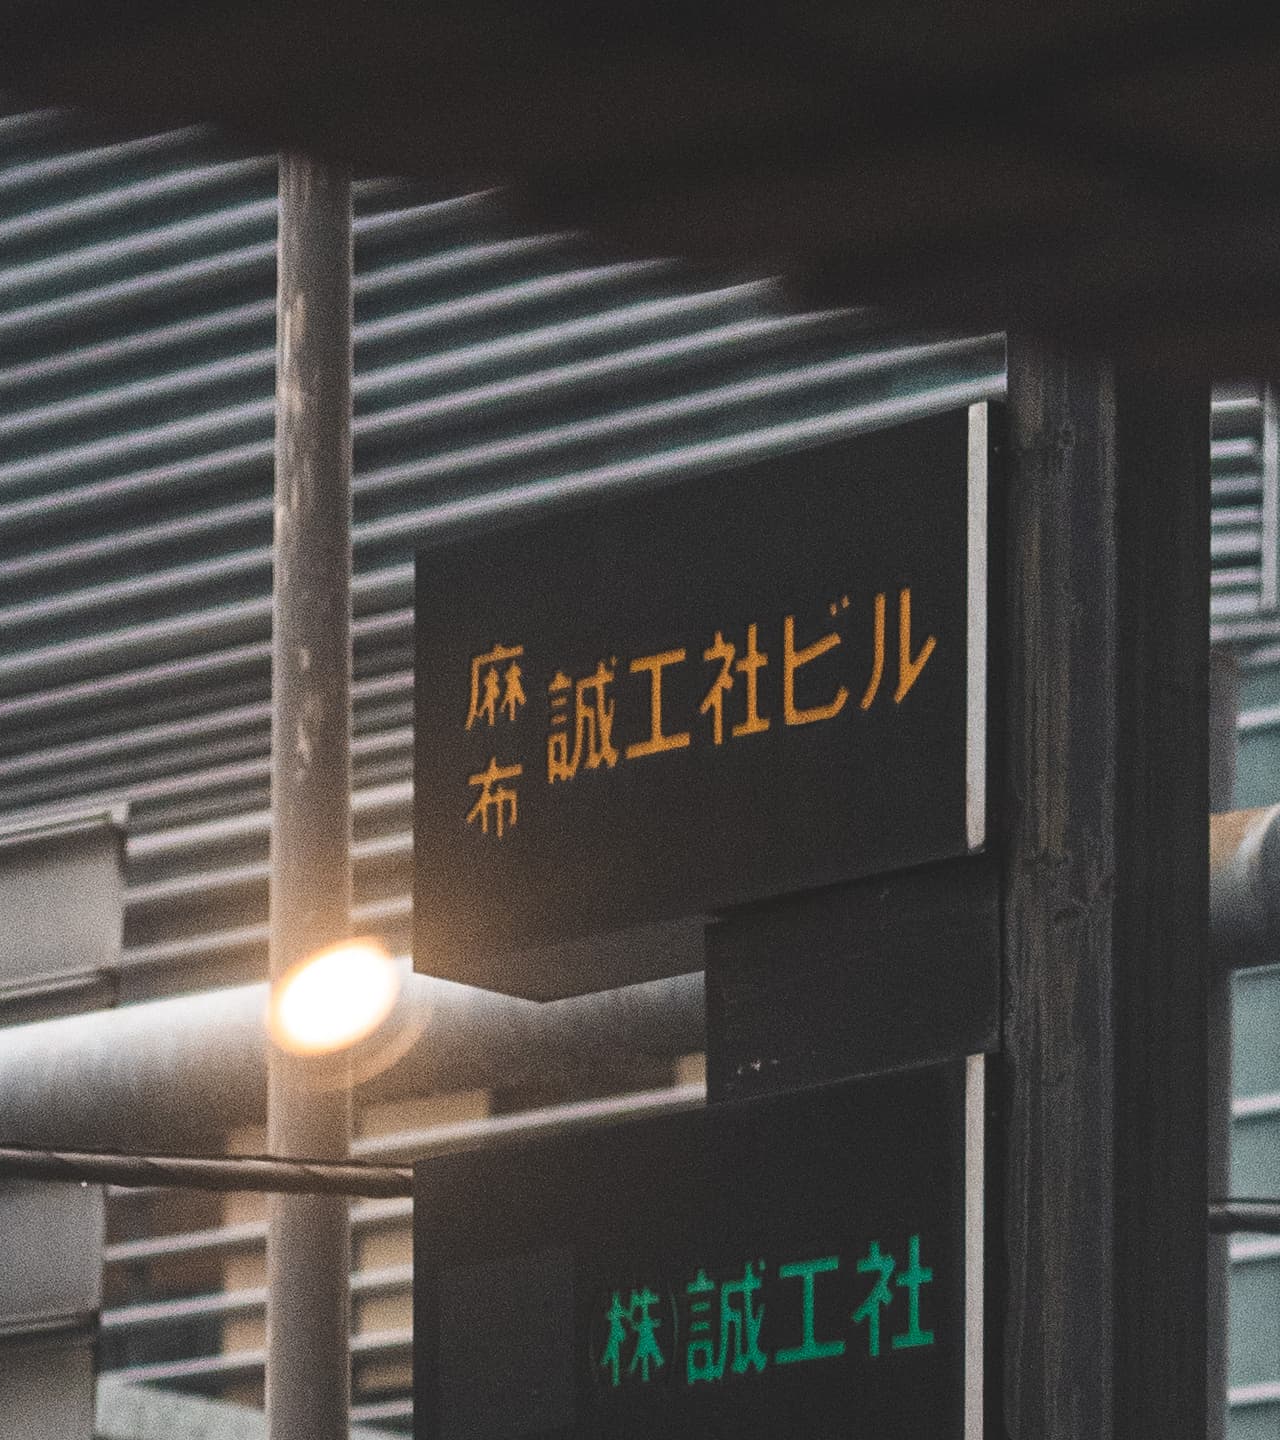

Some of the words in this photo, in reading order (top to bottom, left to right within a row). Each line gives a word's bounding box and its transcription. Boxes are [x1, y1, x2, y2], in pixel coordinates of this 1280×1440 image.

[464, 643, 528, 838] 麻布
[546, 587, 938, 785] 誠工社ビル
